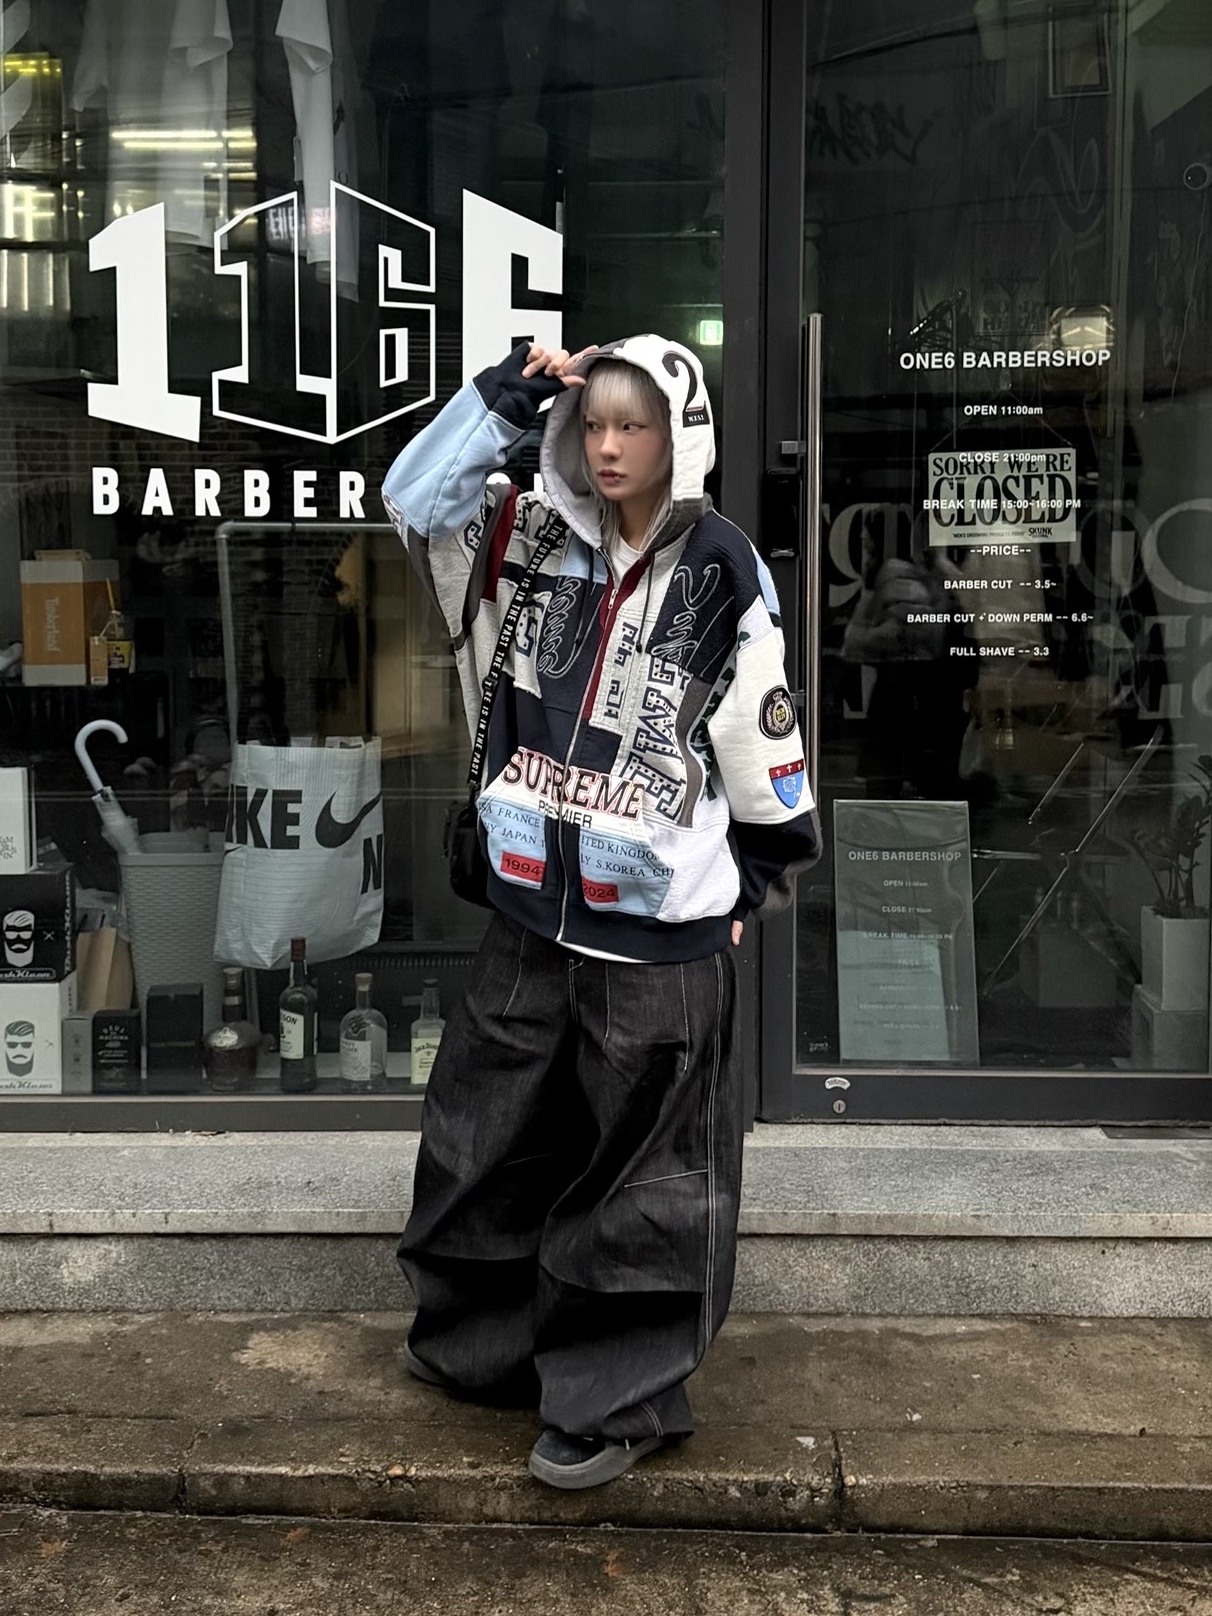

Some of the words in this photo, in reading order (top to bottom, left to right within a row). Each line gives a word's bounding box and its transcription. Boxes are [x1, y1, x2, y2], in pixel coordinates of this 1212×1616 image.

[900, 352, 955, 369] ONE6
[963, 350, 1111, 368] BARBERSHOP
[964, 405, 997, 415] OPEN
[1001, 405, 1043, 415] 11:00am
[959, 452, 999, 462] CLOSE
[1003, 453, 1046, 464] 21:00pm
[92, 467, 365, 519] BARBER
[932, 473, 1074, 527] CLOSED
[923, 500, 964, 509] BREAK
[969, 500, 998, 509] TIME
[1065, 499, 1081, 508] PM
[526, 541, 551, 576] FUTURE
[521, 578, 531, 589] IS
[944, 580, 988, 589] BARBER
[991, 580, 1013, 589] CUT
[507, 603, 521, 622] THE
[907, 614, 950, 623] BARBER
[954, 613, 976, 622] CUT
[988, 613, 1020, 622] DOWN
[1023, 613, 1053, 622] PERM
[499, 623, 514, 648] PAST
[950, 647, 976, 656] FULL
[979, 647, 1015, 656] SHAVE
[1033, 647, 1050, 656] 3.3
[482, 705, 489, 716] IS
[475, 732, 485, 751] THE
[471, 752, 481, 776] PAST
[498, 807, 540, 828] FRANCE
[501, 828, 537, 845] JAPAN
[849, 851, 879, 860] ONE6
[882, 851, 961, 861] BARBERSHOP
[505, 858, 540, 877] 1994
[596, 860, 645, 878] S.KOREA
